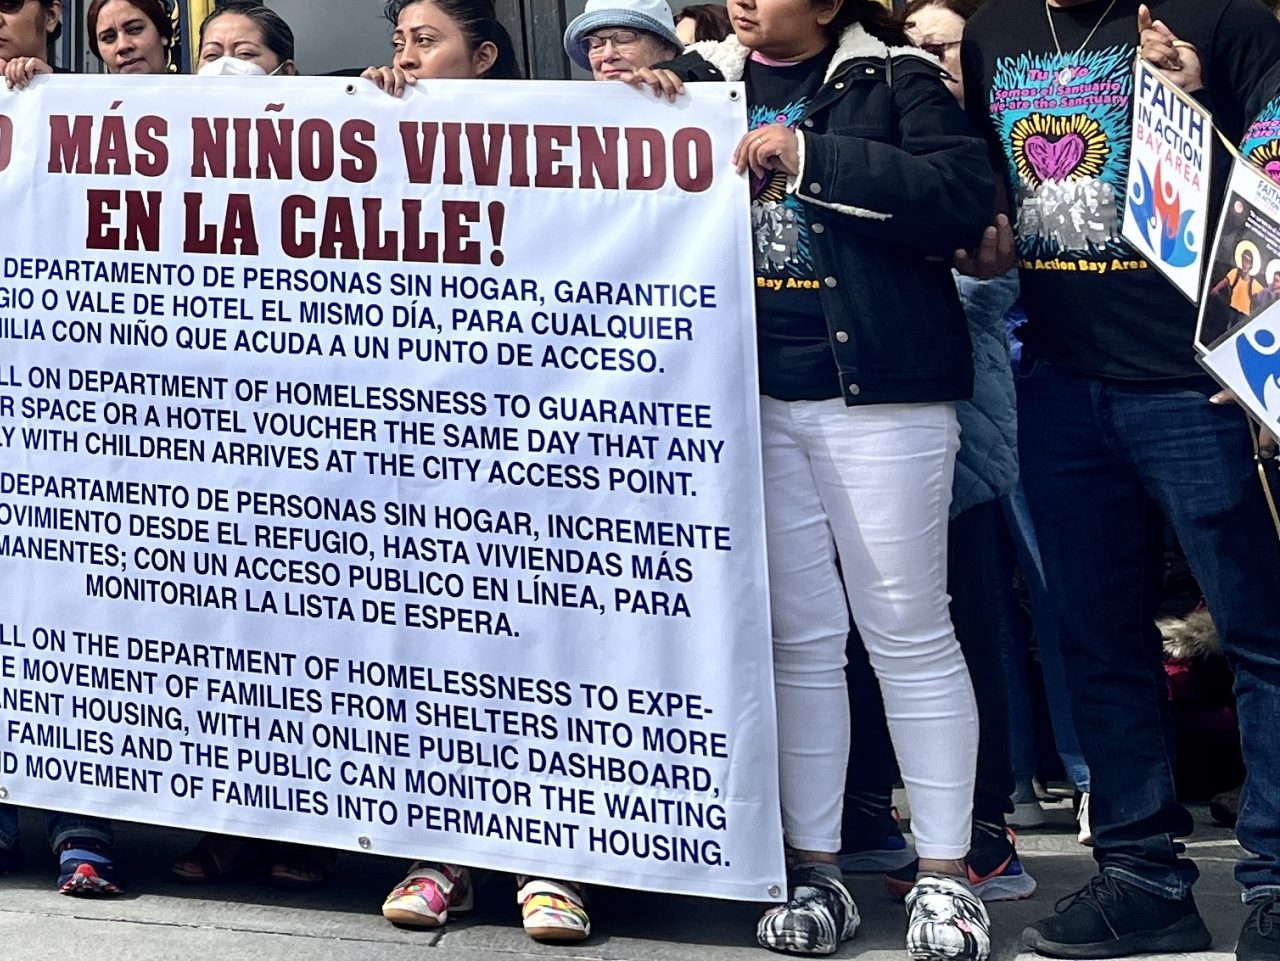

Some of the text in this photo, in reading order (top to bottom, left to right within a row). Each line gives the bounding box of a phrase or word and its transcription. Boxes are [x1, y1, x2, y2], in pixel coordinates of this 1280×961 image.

[995, 80, 1121, 100] Somos el Santuario
[1009, 100, 1031, 110] are
[1034, 98, 1057, 109] the
[1060, 95, 1129, 107] Sanctuary
[1029, 69, 1049, 81] Tu
[1140, 67, 1204, 148] FAITH
[48, 100, 169, 177] MÁS
[191, 102, 377, 183] NIÑOS
[399, 120, 714, 193] VIVIENDO
[1137, 124, 1200, 191] BAY AREA
[1138, 103, 1202, 172] IN ACTION
[86, 189, 505, 267] EN LA CALLE!
[3, 257, 195, 287] DEPARTAMENTO
[202, 265, 235, 289] DE
[243, 267, 382, 296] PERSONAS
[389, 272, 432, 298] SIN
[441, 275, 545, 307] HOGAR,
[554, 279, 717, 309] GARANTICE
[756, 276, 820, 291] Bay Area
[1035, 258, 1148, 273] Action Bay Area
[41, 288, 59, 311] O
[65, 289, 126, 315] VALE
[133, 293, 165, 316] DE
[172, 294, 254, 321] HOTEL
[261, 299, 292, 323] EL
[299, 300, 384, 328] MISMO
[392, 299, 443, 335] DÍA,
[451, 307, 525, 334] PARA
[531, 311, 694, 342] CUALQUIER
[51, 319, 102, 344] CON
[110, 318, 168, 348] NIÑO
[175, 325, 228, 351] QUE
[233, 329, 324, 356] ACUDA
[328, 334, 347, 357] A
[354, 335, 389, 360] UN
[398, 337, 489, 365] PUNTO
[497, 342, 534, 367] DE
[540, 344, 665, 374] ACCESO.
[21, 396, 97, 423] SPACE
[103, 401, 138, 427] OR
[143, 404, 161, 428] A
[166, 405, 247, 434] HOTEL
[252, 411, 377, 443] VOUCHER
[383, 419, 436, 446] THE
[443, 423, 520, 452] SAME
[527, 428, 581, 456] DAY
[586, 431, 660, 460] THAT
[666, 436, 725, 464] ANY
[28, 366, 61, 390] ON
[68, 368, 229, 400] DEPARTMENT
[234, 378, 269, 403] OF
[275, 380, 488, 417] HOMELESSNESS
[493, 393, 531, 419] TO
[538, 395, 713, 429] GUARANTEE
[21, 427, 78, 453] WITH
[85, 431, 205, 463] CHILDREN
[211, 440, 320, 472] ARRIVES
[325, 448, 358, 474] AT
[362, 451, 416, 478] THE
[422, 455, 482, 483] CITY
[487, 459, 601, 491] ACCESS
[608, 467, 697, 497] POINT.
[0, 471, 190, 509] DEPARTAMENTO
[197, 487, 230, 513] DE
[236, 490, 377, 524] PERSONAS
[383, 501, 426, 528] SIN
[434, 505, 540, 542] HOGAR,
[547, 513, 732, 552] INCREMENTE
[32, 626, 66, 653] ON
[72, 631, 120, 659] THE
[127, 636, 297, 677] DEPARTMENT
[304, 655, 340, 682] OF
[347, 659, 573, 707] HOMELESSNESS
[579, 683, 619, 712] TO
[627, 688, 713, 721] EXPE-
[22, 657, 159, 695] MOVEMENT
[165, 673, 199, 699] OF
[206, 678, 323, 714] FAMILIES
[330, 691, 407, 724] FROM
[415, 700, 559, 741] SHELTERS
[566, 716, 633, 749] INTO
[642, 725, 729, 759] MORE
[25, 754, 164, 794] MOVEMENT
[170, 772, 204, 799] OF
[212, 778, 329, 816] FAMILIES
[336, 793, 398, 826] INTO
[407, 802, 580, 850] PERMANENT
[588, 826, 731, 867] HOUSING.
